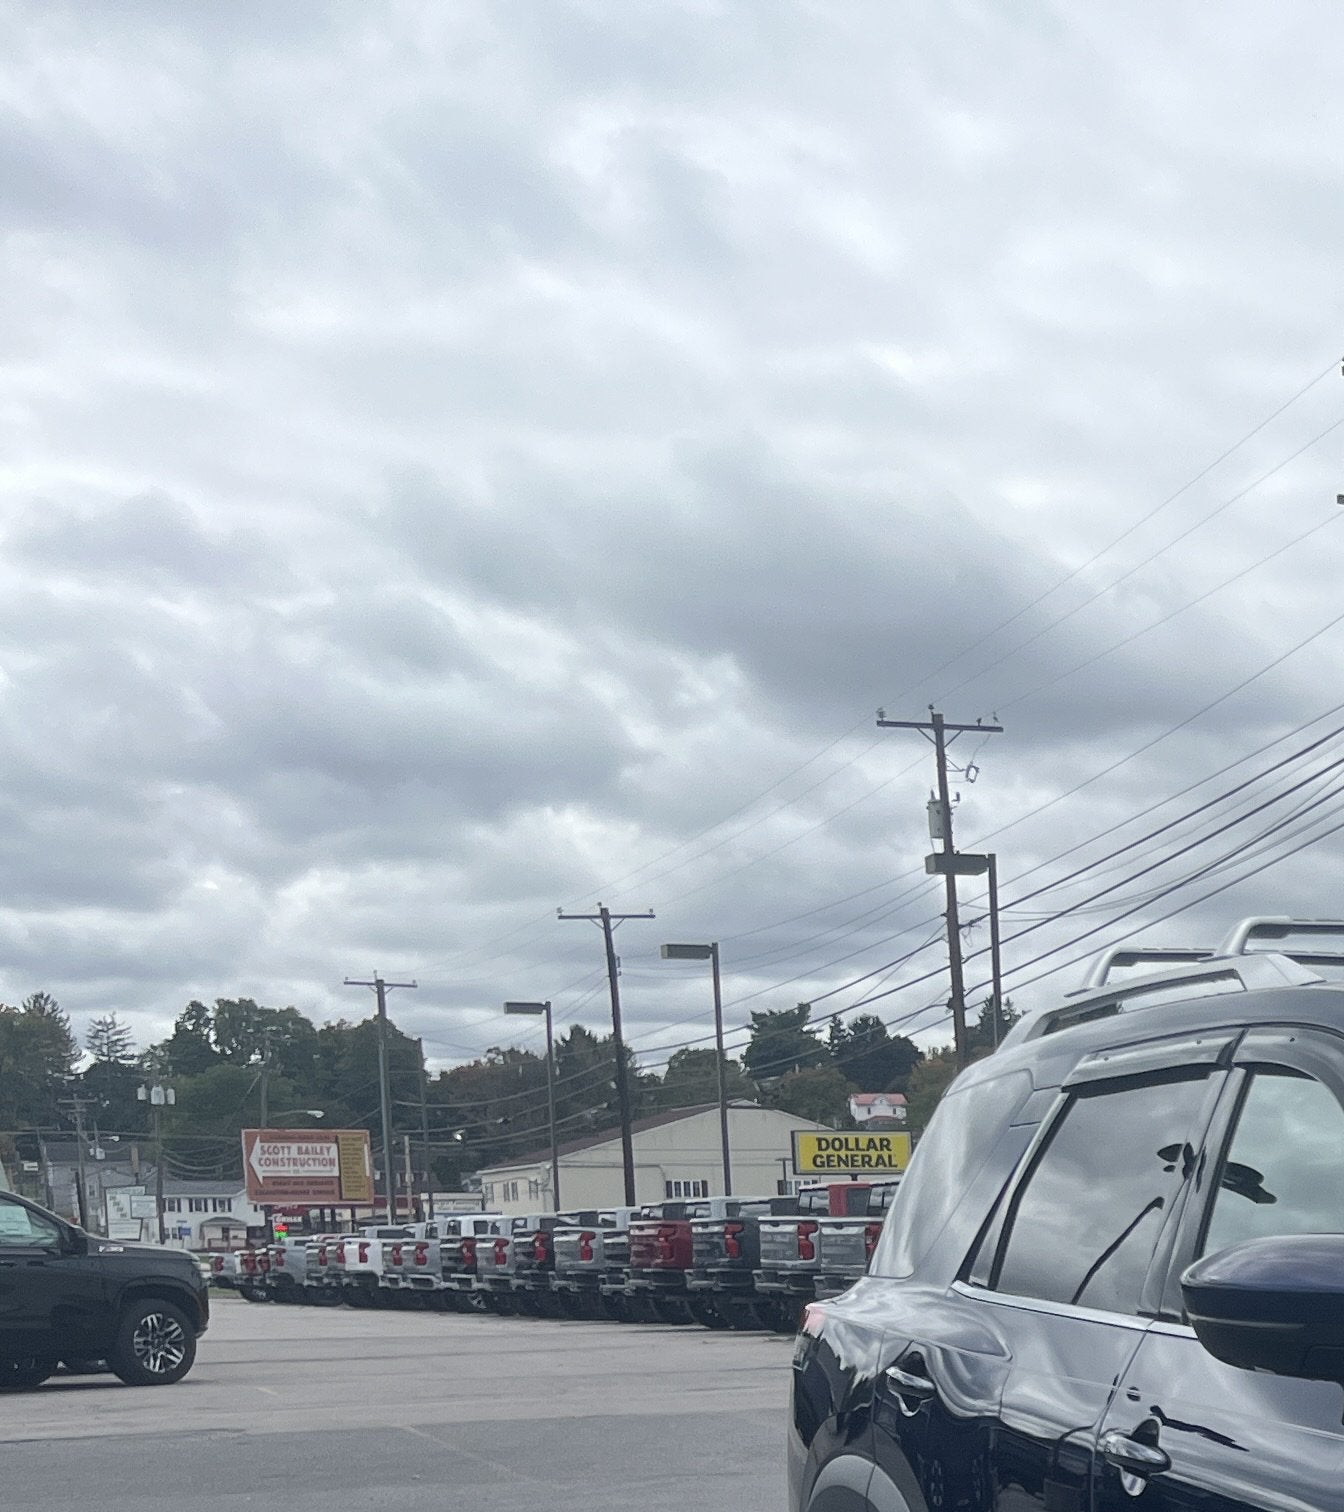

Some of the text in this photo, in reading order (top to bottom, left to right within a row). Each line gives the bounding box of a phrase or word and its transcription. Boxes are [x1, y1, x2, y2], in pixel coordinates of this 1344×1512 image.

[260, 1145, 332, 1156] SCOTT BAILEY
[816, 1137, 892, 1152] DOLLAR
[258, 1157, 336, 1168] CONSTRUCTION
[812, 1154, 898, 1168] GENERAL
